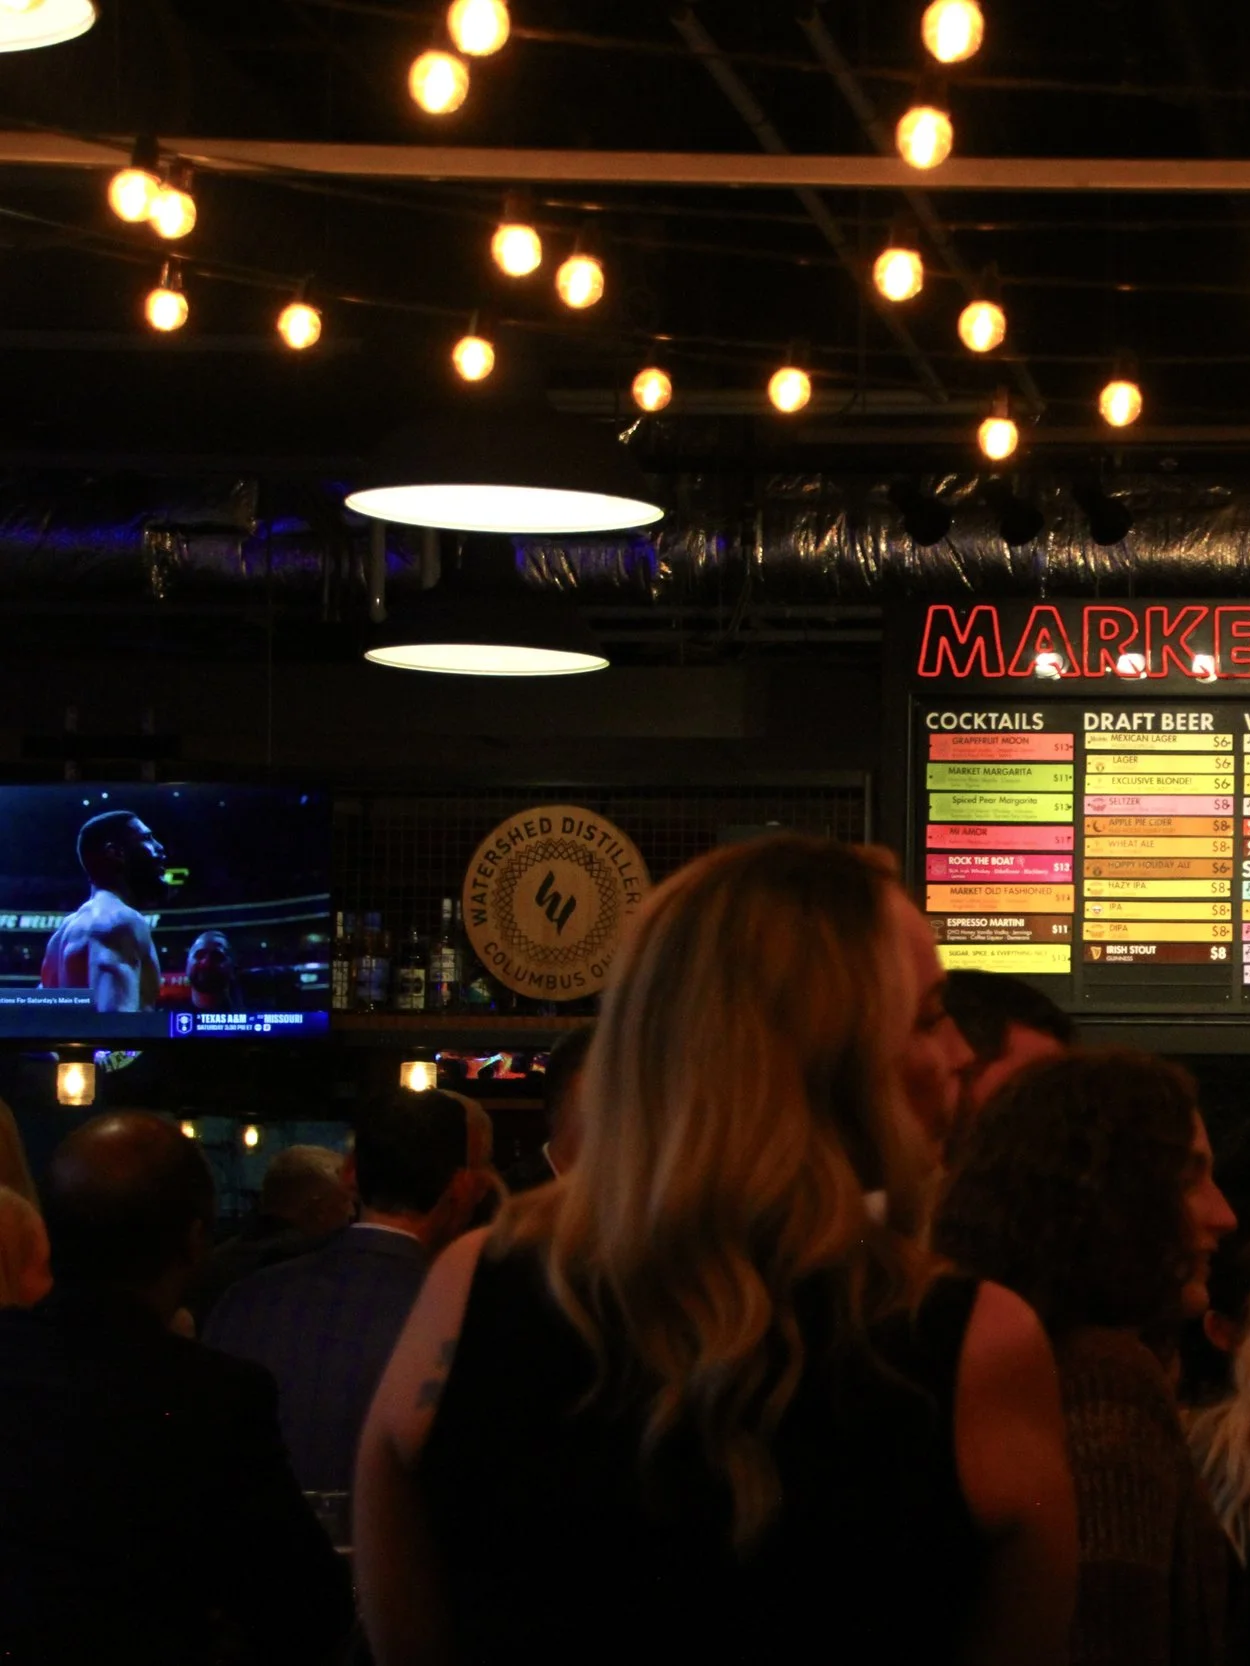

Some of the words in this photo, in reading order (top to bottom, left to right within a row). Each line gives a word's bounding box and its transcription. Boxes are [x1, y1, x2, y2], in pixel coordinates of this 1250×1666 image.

[926, 712, 1044, 730] COCKTAILS
[1084, 713, 1156, 730] DRAFT
[1161, 713, 1214, 731] BEER
[1002, 736, 1029, 745] MOON
[1111, 734, 1149, 742] MEXICAN
[1213, 736, 1228, 748] $6
[1113, 756, 1138, 764] LAGER
[1215, 758, 1230, 769] $6
[948, 767, 981, 775] MARKET
[983, 767, 1032, 776] MARGARITA
[1112, 777, 1154, 785] EXCLUSIVE
[1214, 778, 1229, 789] $6
[952, 796, 977, 805] Spiced
[979, 796, 996, 804] Pear
[1000, 796, 1038, 806] Margarita
[1214, 799, 1229, 810] $8
[1109, 818, 1133, 826] APPLE
[1135, 818, 1148, 826] PIE
[1150, 818, 1172, 826] CIDER
[1213, 820, 1228, 831] $8
[1108, 840, 1138, 848] WHEAT
[1141, 840, 1155, 848] ALE
[1212, 841, 1227, 852] $8
[948, 857, 972, 865] ROCK
[974, 857, 989, 865] THE
[991, 857, 1015, 865] BOAT
[470, 817, 552, 927] WATERSHED
[561, 817, 643, 915] DISTILLER
[1212, 862, 1227, 874] $6
[950, 887, 982, 895] MARKET
[985, 887, 1001, 895] OLD
[1004, 887, 1052, 895] FASHIONED
[1211, 882, 1226, 893] $8
[1109, 903, 1122, 911] IPA
[1212, 905, 1226, 916] $8
[947, 919, 987, 927] ESPRESSO
[990, 919, 1025, 927] MARTINI
[1052, 925, 1068, 934] $11
[1109, 924, 1128, 932] DIPA
[1212, 926, 1227, 937] $8
[1106, 946, 1127, 954] IRISH
[1129, 946, 1156, 954] STOUT
[1210, 946, 1227, 960] $8
[484, 941, 586, 990] COLUMBUS
[201, 1014, 226, 1023] TEXAS
[228, 1014, 246, 1023] A&M
[264, 1014, 303, 1023] MISSOURI
